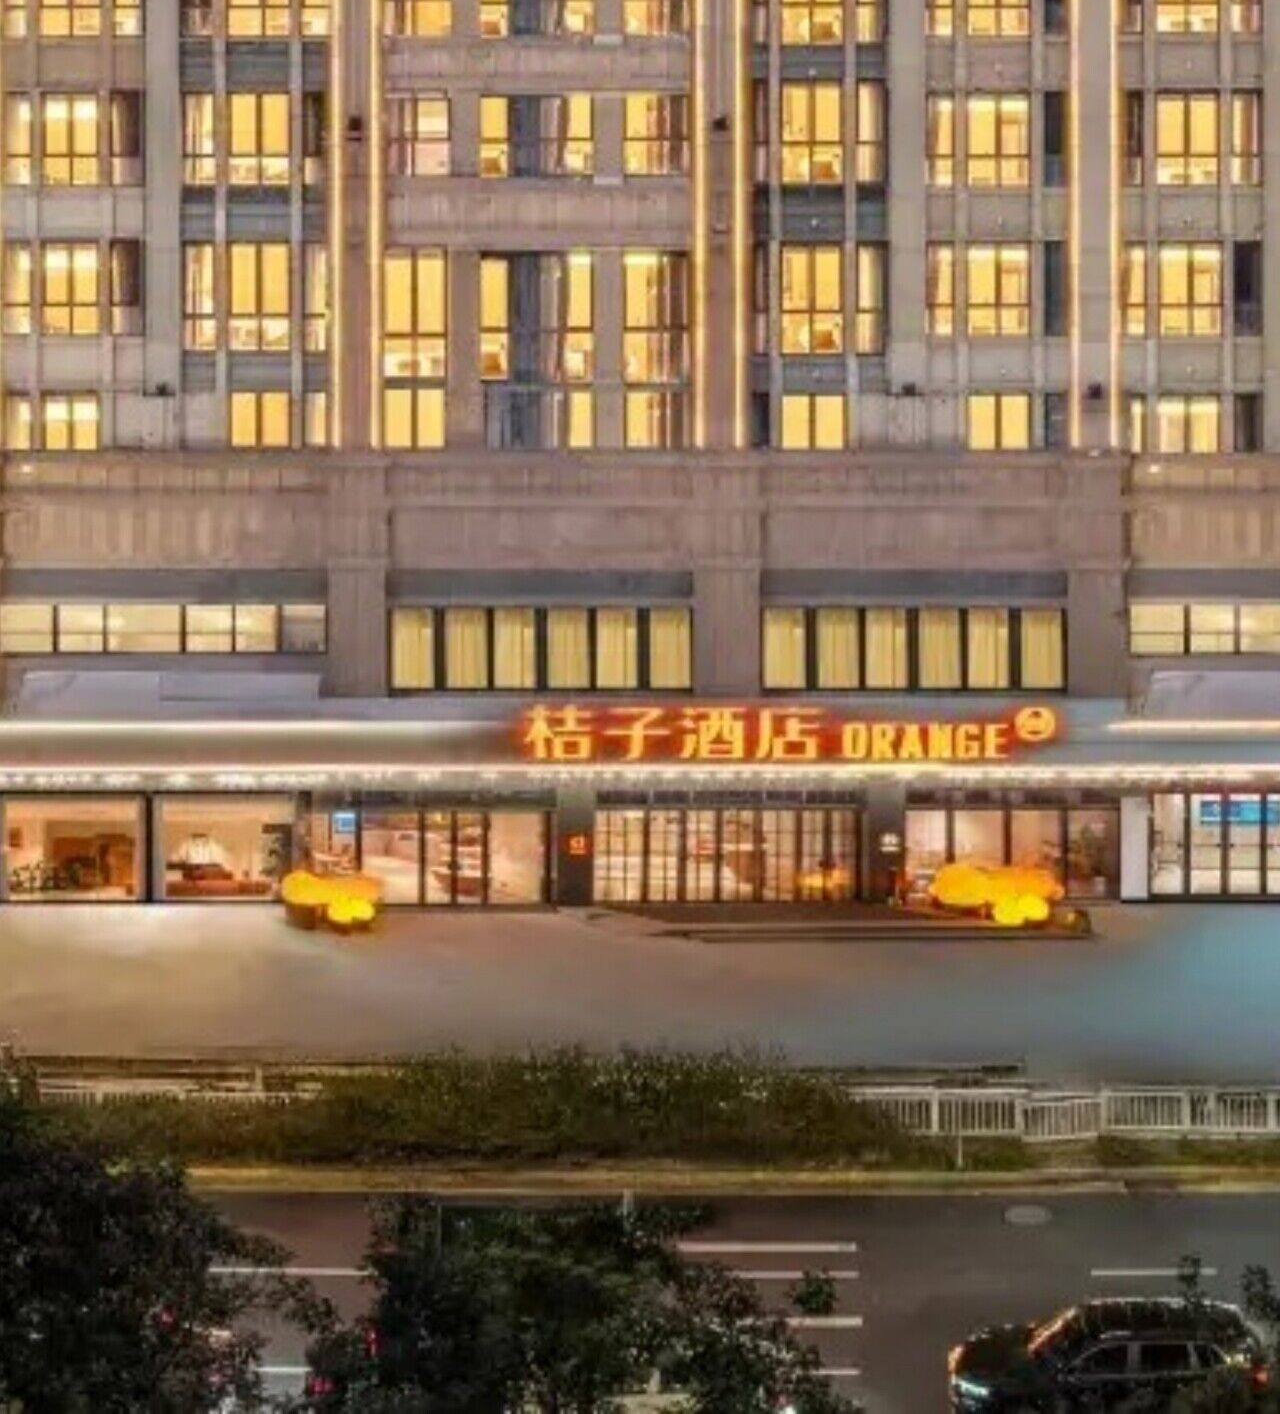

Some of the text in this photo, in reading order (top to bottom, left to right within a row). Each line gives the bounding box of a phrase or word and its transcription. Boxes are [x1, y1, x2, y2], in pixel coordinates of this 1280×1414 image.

[523, 703, 1009, 759] 桔子酒店 ORANGE
